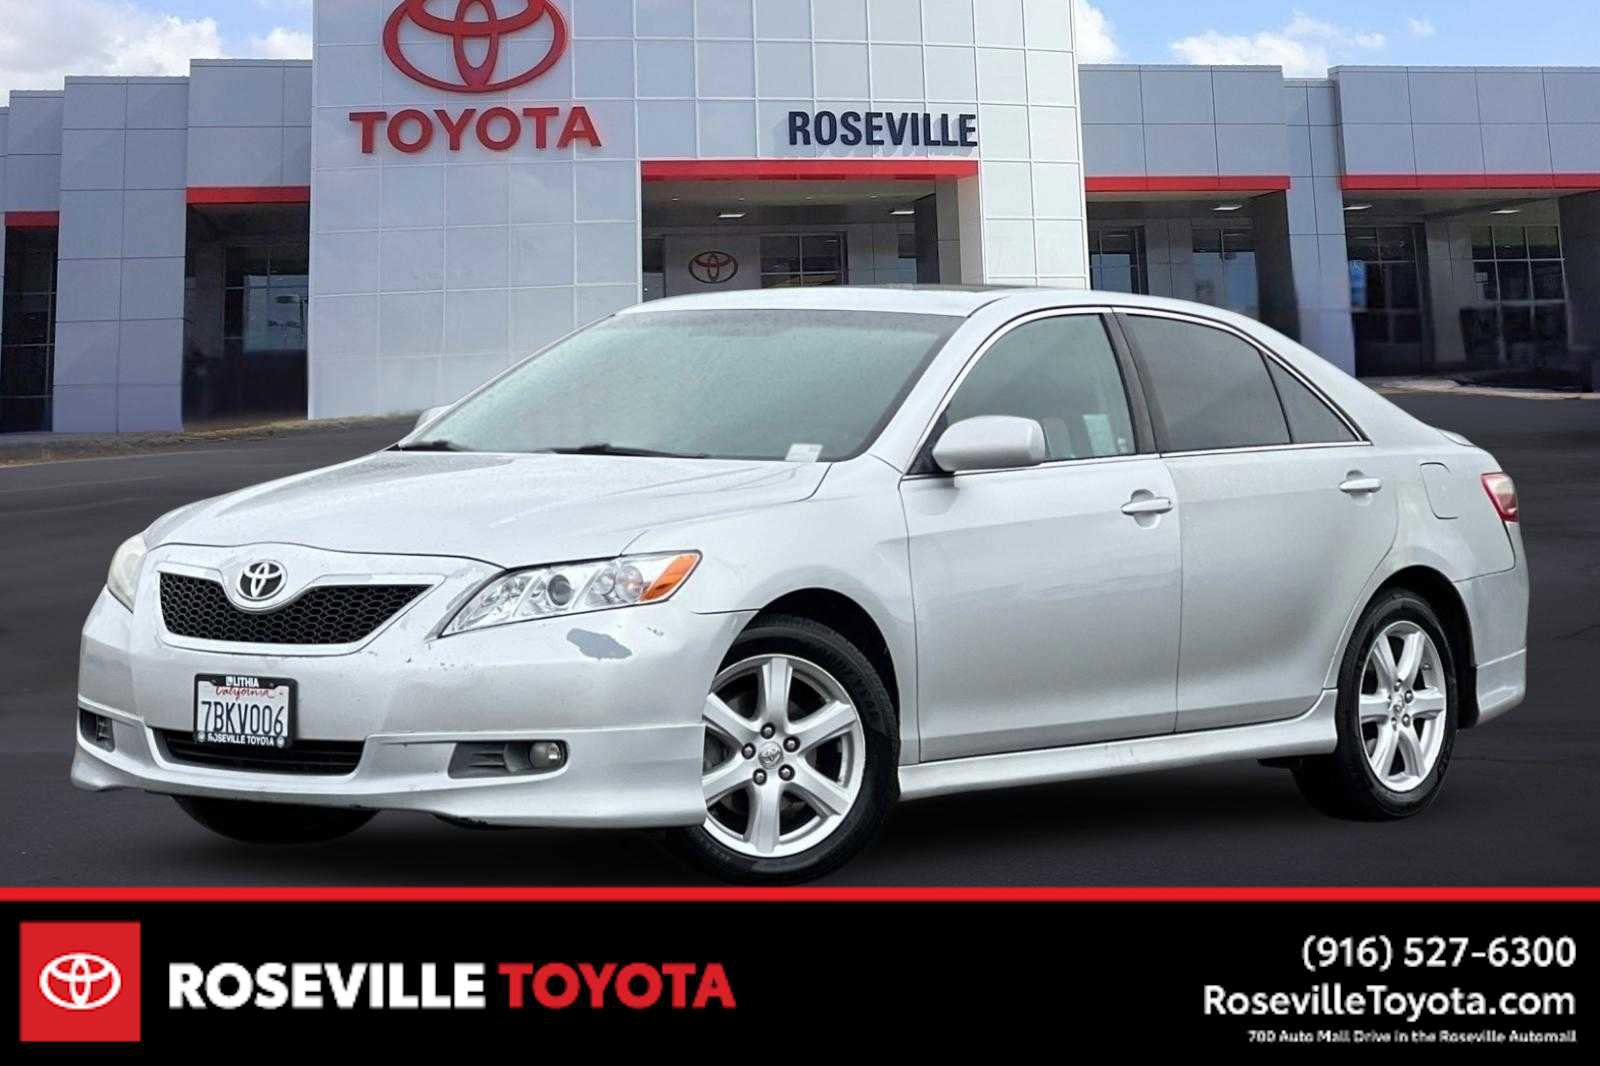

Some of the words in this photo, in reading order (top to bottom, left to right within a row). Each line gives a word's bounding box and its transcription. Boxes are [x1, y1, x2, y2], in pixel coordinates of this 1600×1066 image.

[349, 106, 602, 154] TOYOTA
[788, 111, 978, 147] ROSEVILLE
[201, 701, 284, 736] 7BKV006
[207, 733, 245, 744] ROSEVILLE
[247, 736, 274, 746] TOYOTA
